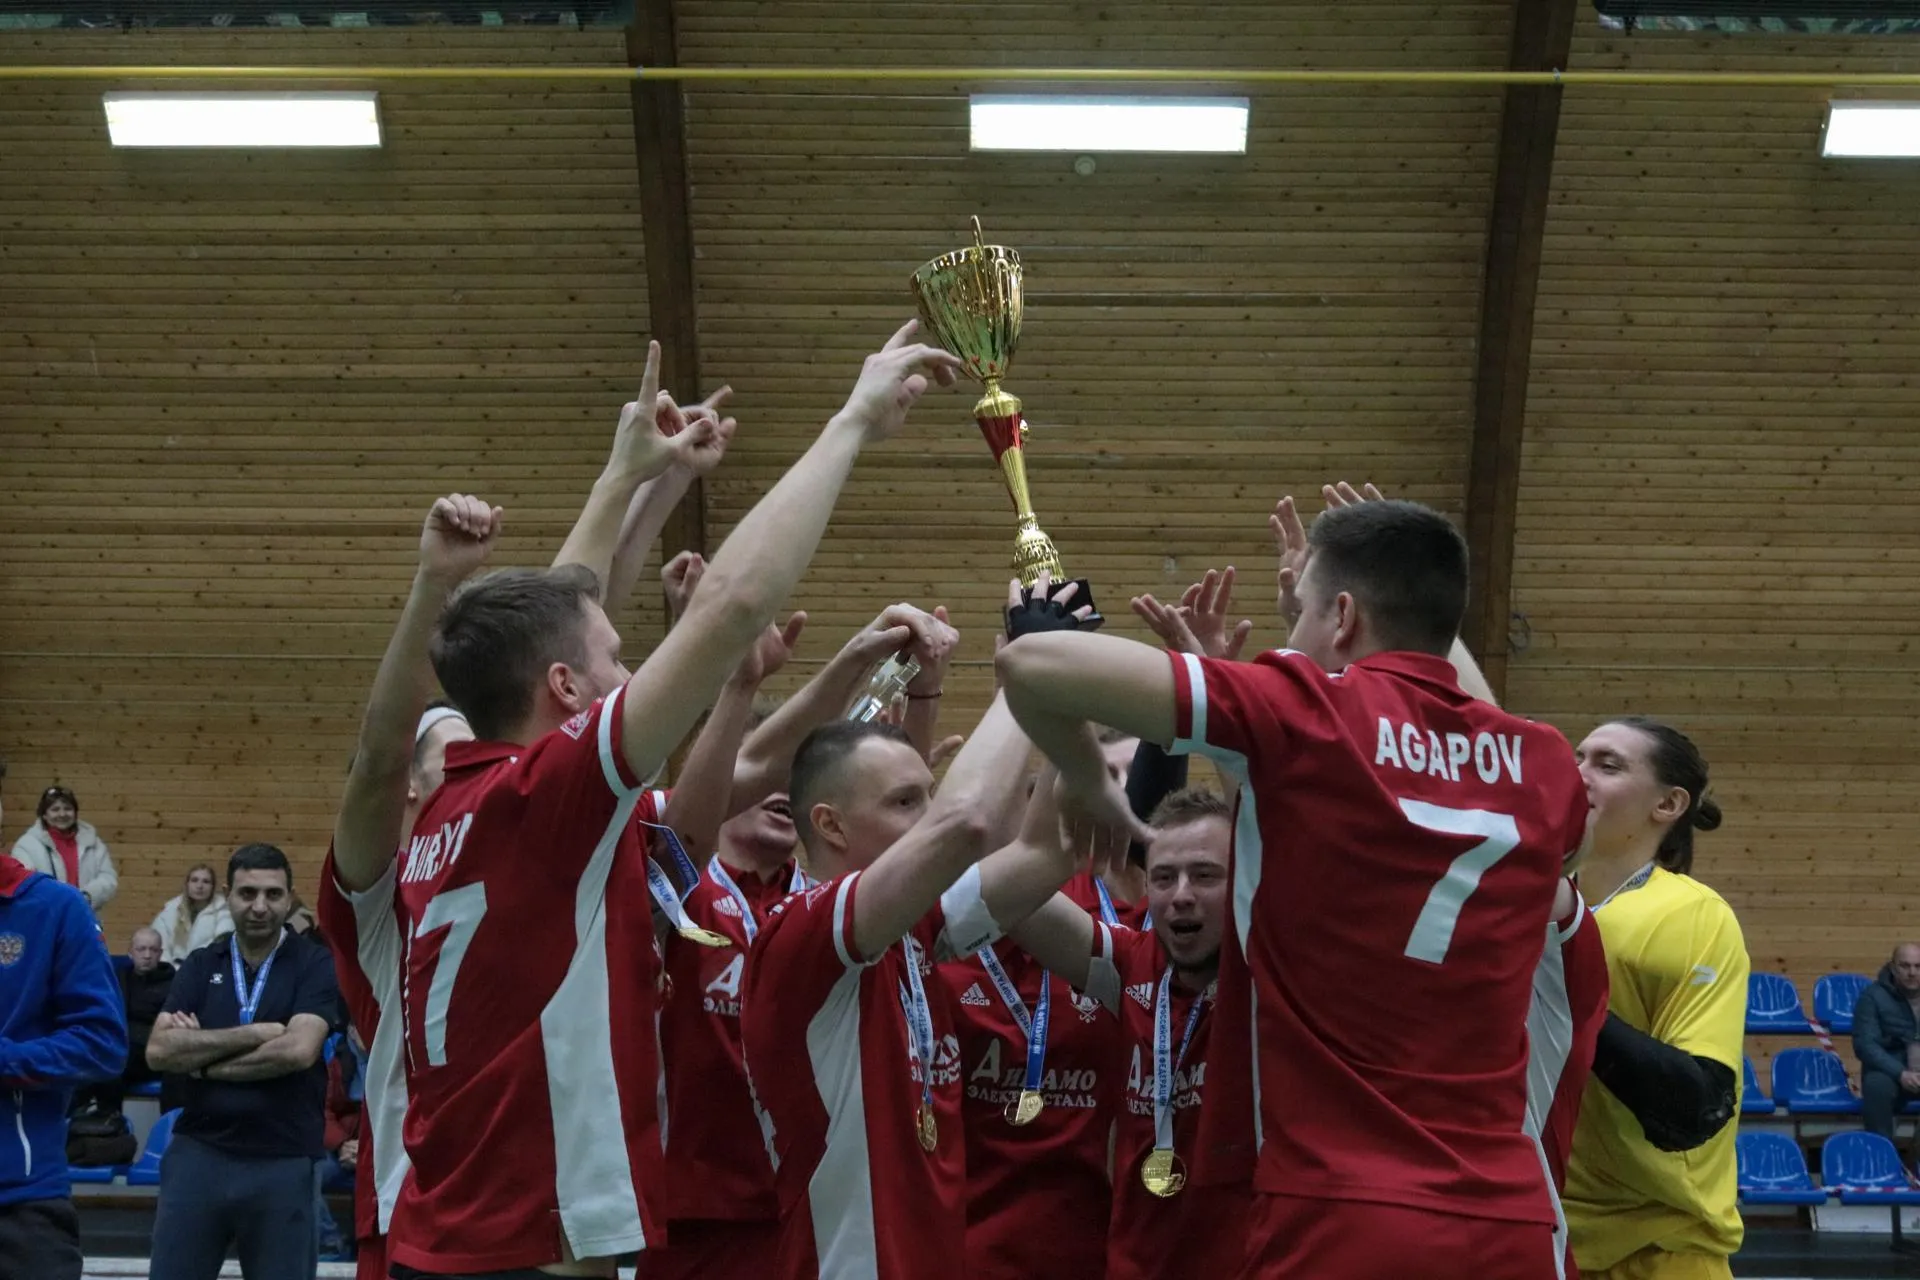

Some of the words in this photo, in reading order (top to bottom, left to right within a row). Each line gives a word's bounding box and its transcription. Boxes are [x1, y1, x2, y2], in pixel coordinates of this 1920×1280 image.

[1375, 717, 1522, 784] AGAPOV
[1398, 797, 1521, 964] 7
[960, 996, 990, 1006] adidas
[1125, 986, 1151, 1010] adidas
[970, 1038, 1097, 1091] ДИАМО
